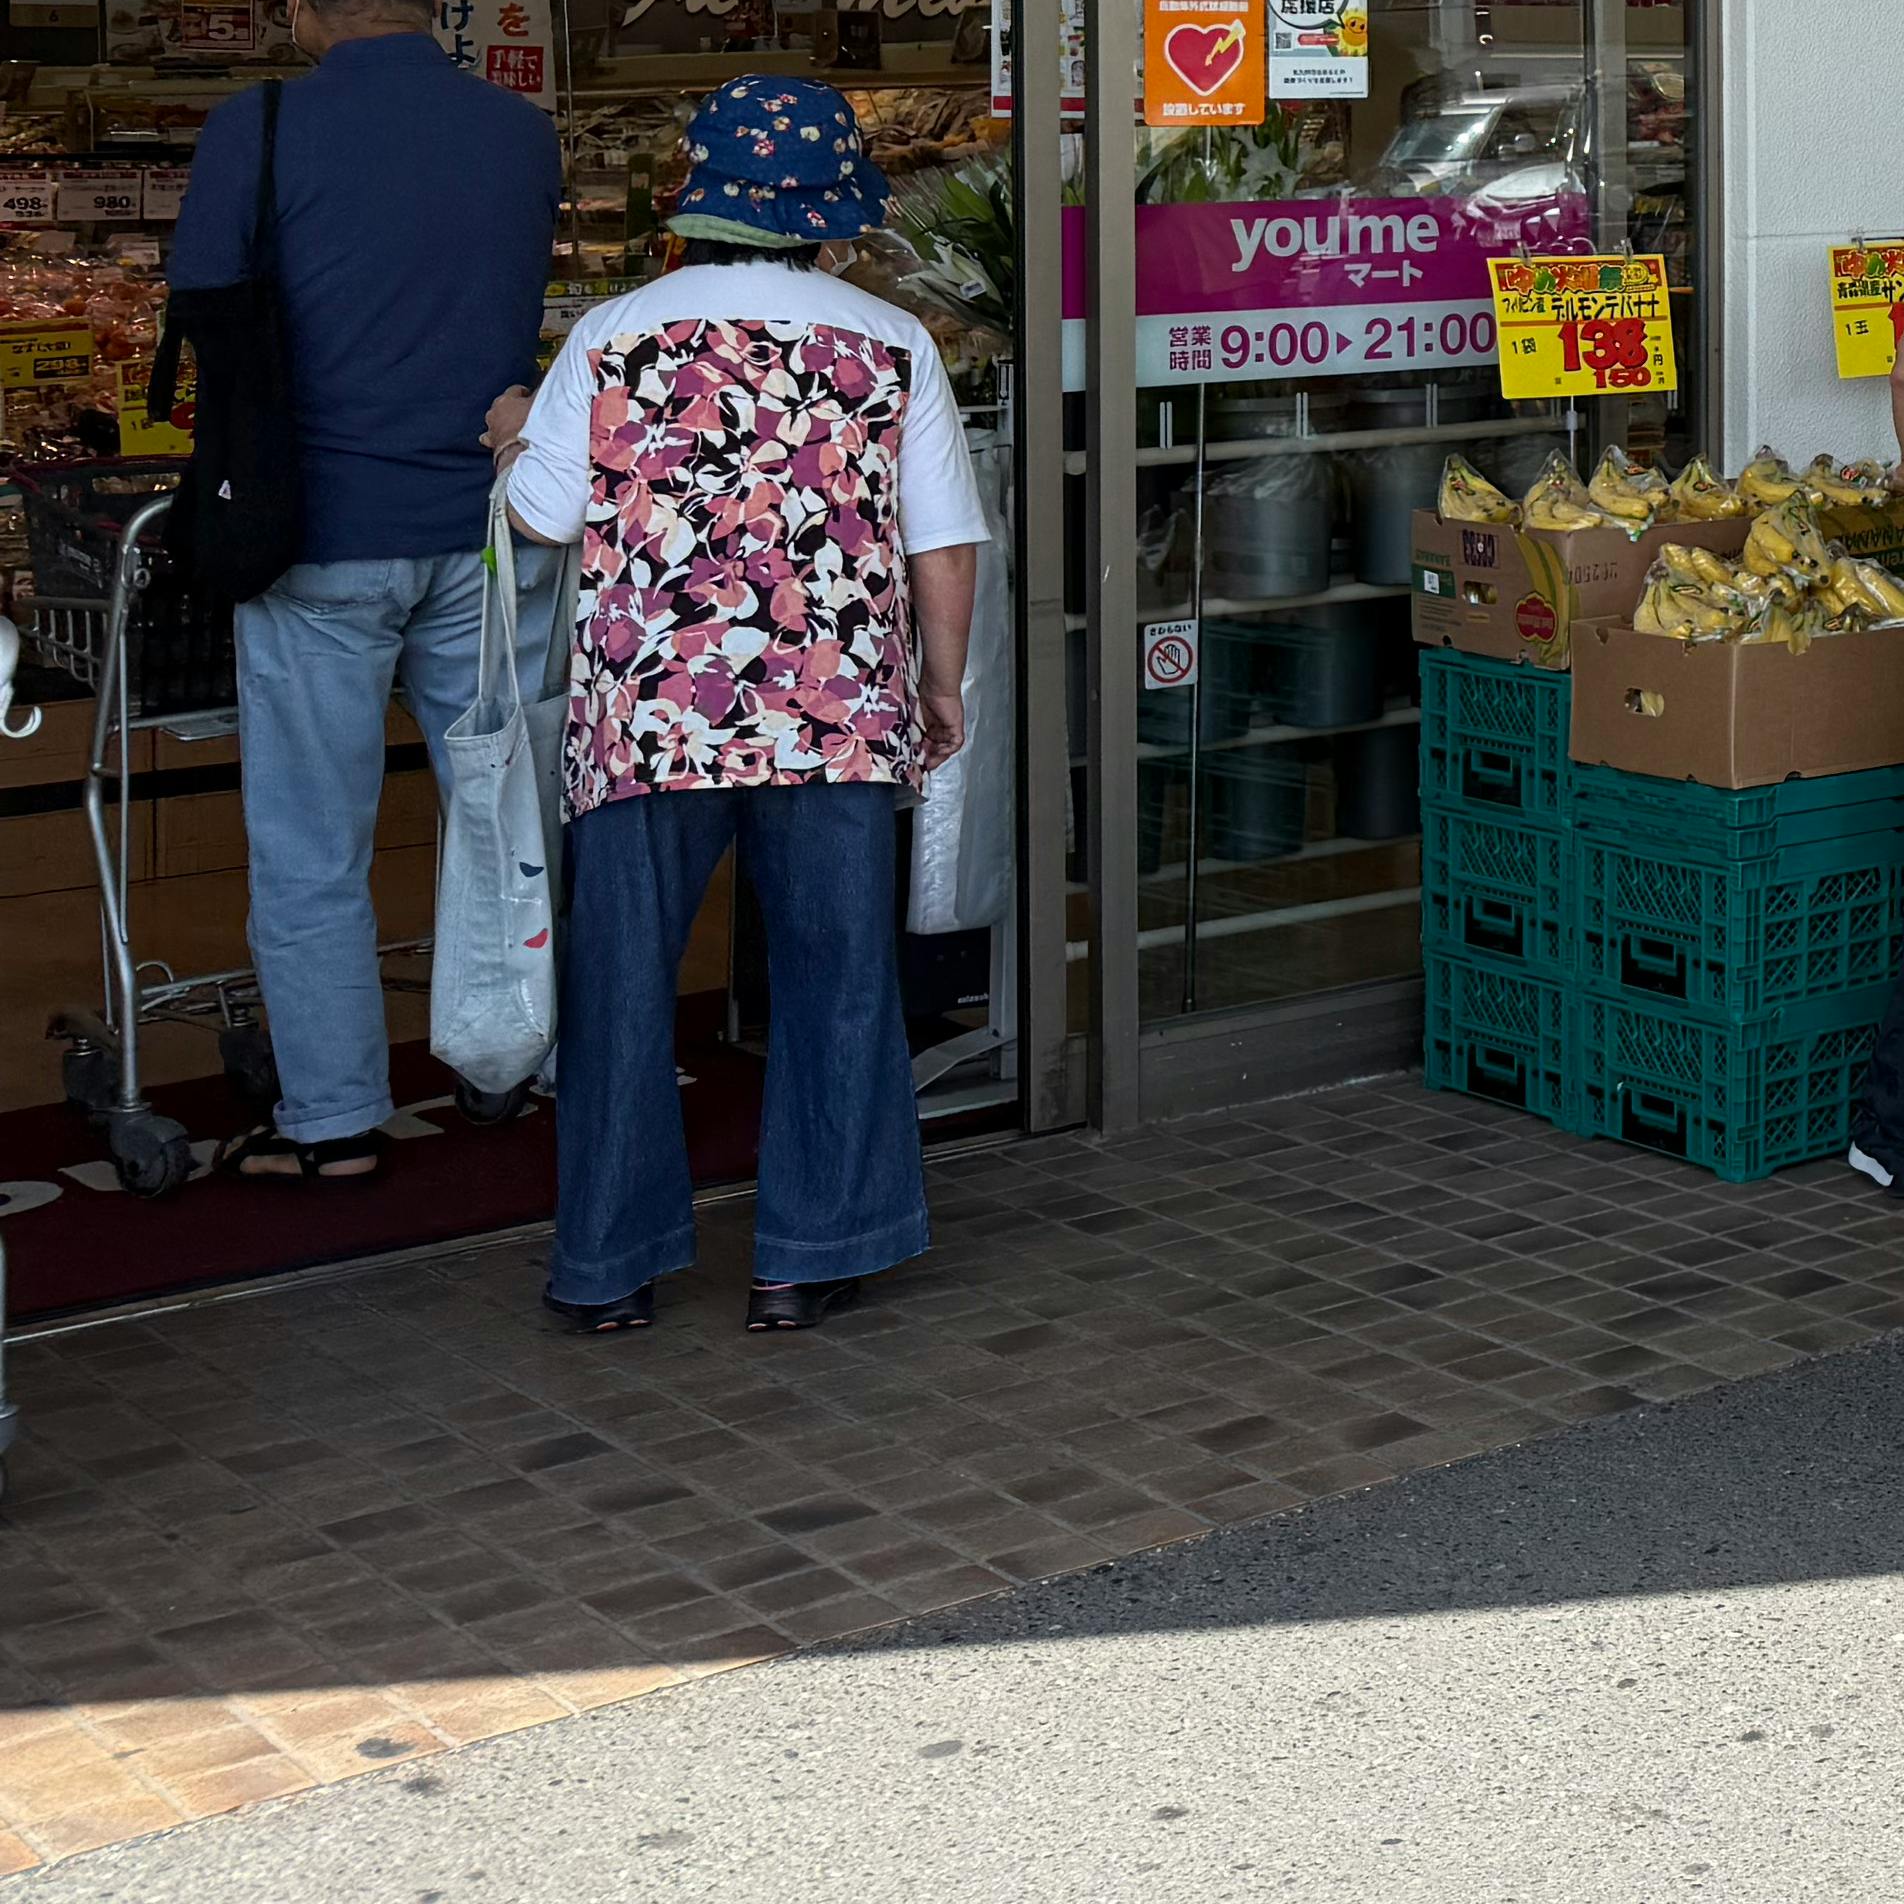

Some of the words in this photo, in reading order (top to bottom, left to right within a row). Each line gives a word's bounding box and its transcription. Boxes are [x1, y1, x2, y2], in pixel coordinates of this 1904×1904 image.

[93, 195, 132, 210] 980
[1230, 212, 1440, 273] youme
[1344, 259, 1424, 289] マート
[1168, 325, 1212, 348] 営業
[1220, 321, 1330, 370] 9:00
[1363, 312, 1498, 361] 21:00
[1168, 350, 1212, 372] 時間
[1558, 318, 1648, 372] 138
